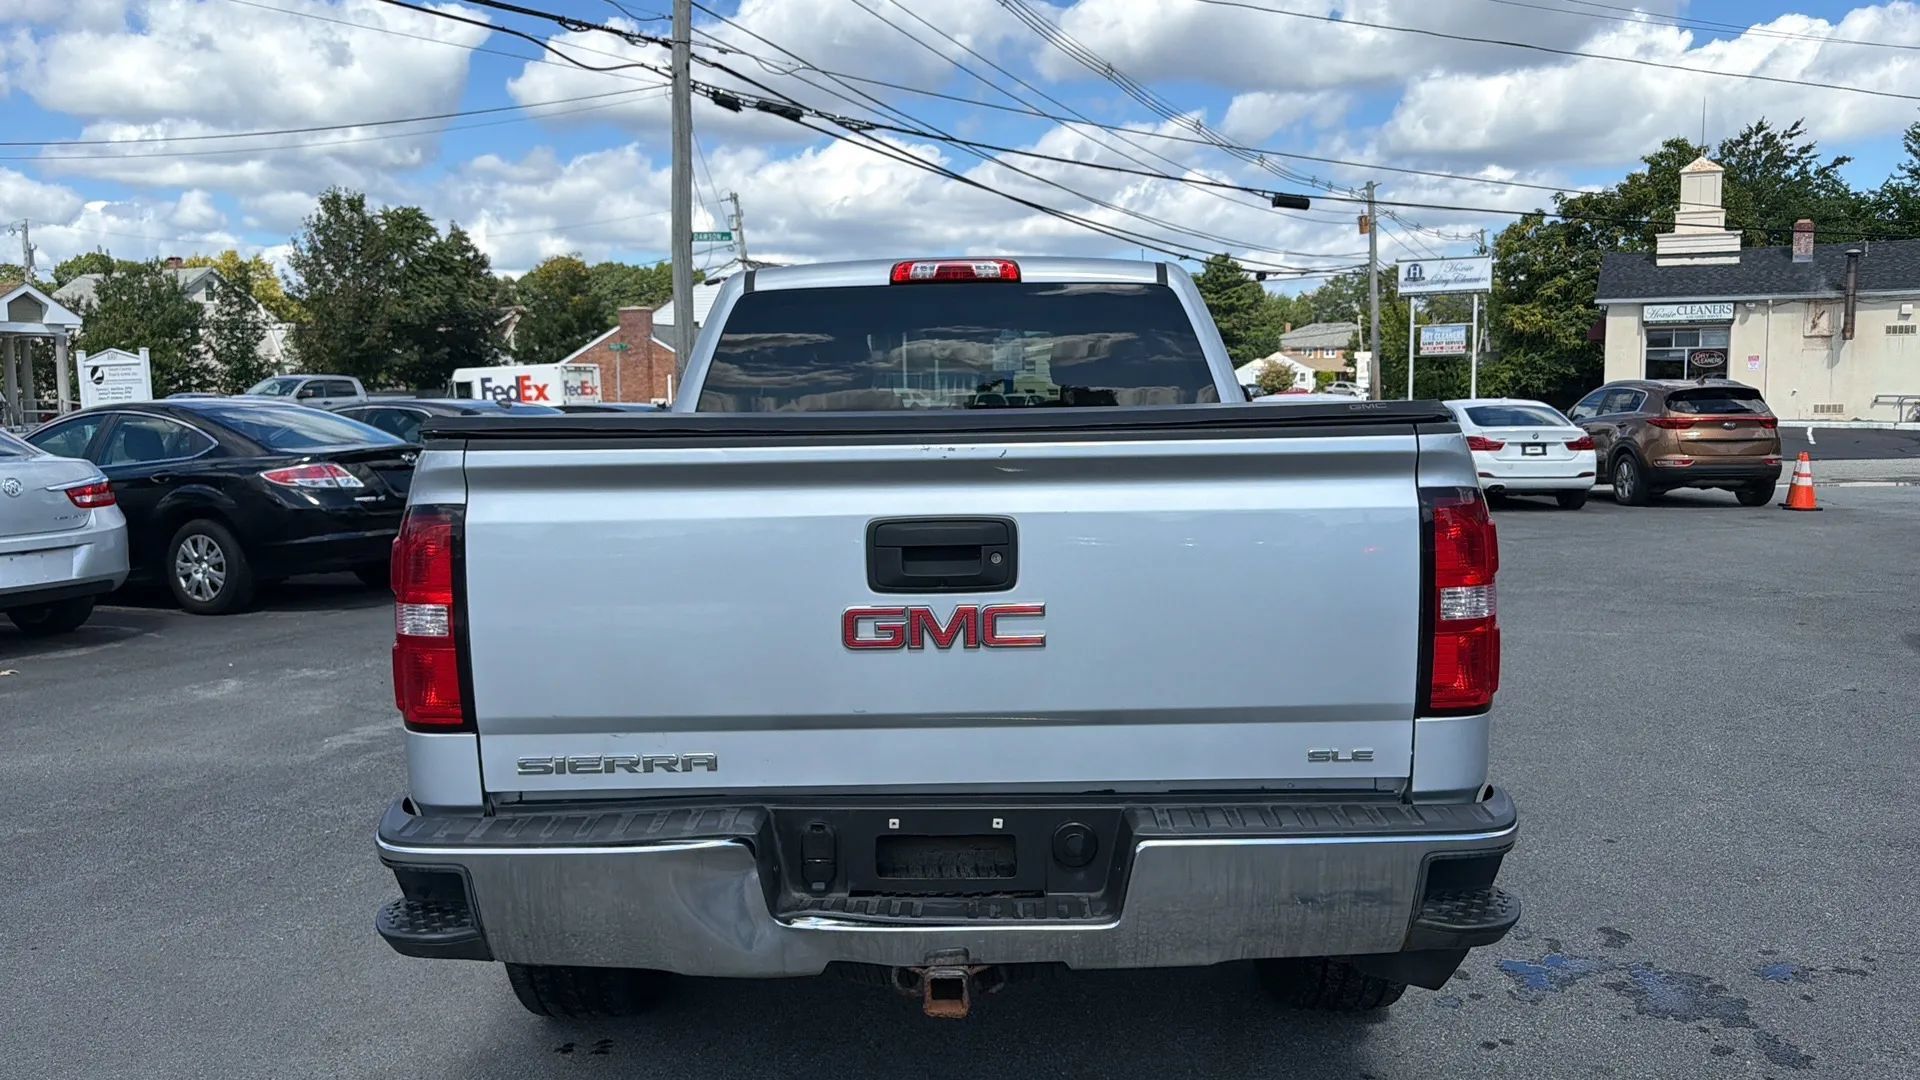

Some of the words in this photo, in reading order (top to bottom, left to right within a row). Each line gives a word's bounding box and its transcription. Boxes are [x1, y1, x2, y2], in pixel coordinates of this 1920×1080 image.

[693, 233, 721, 241] DAWSON
[1677, 304, 1733, 315] CLEANERS
[480, 375, 549, 401] FedEx
[563, 380, 599, 397] FedEx
[841, 602, 1046, 650] GMC
[517, 753, 718, 775] SIERRA
[1308, 749, 1374, 763] SLE
